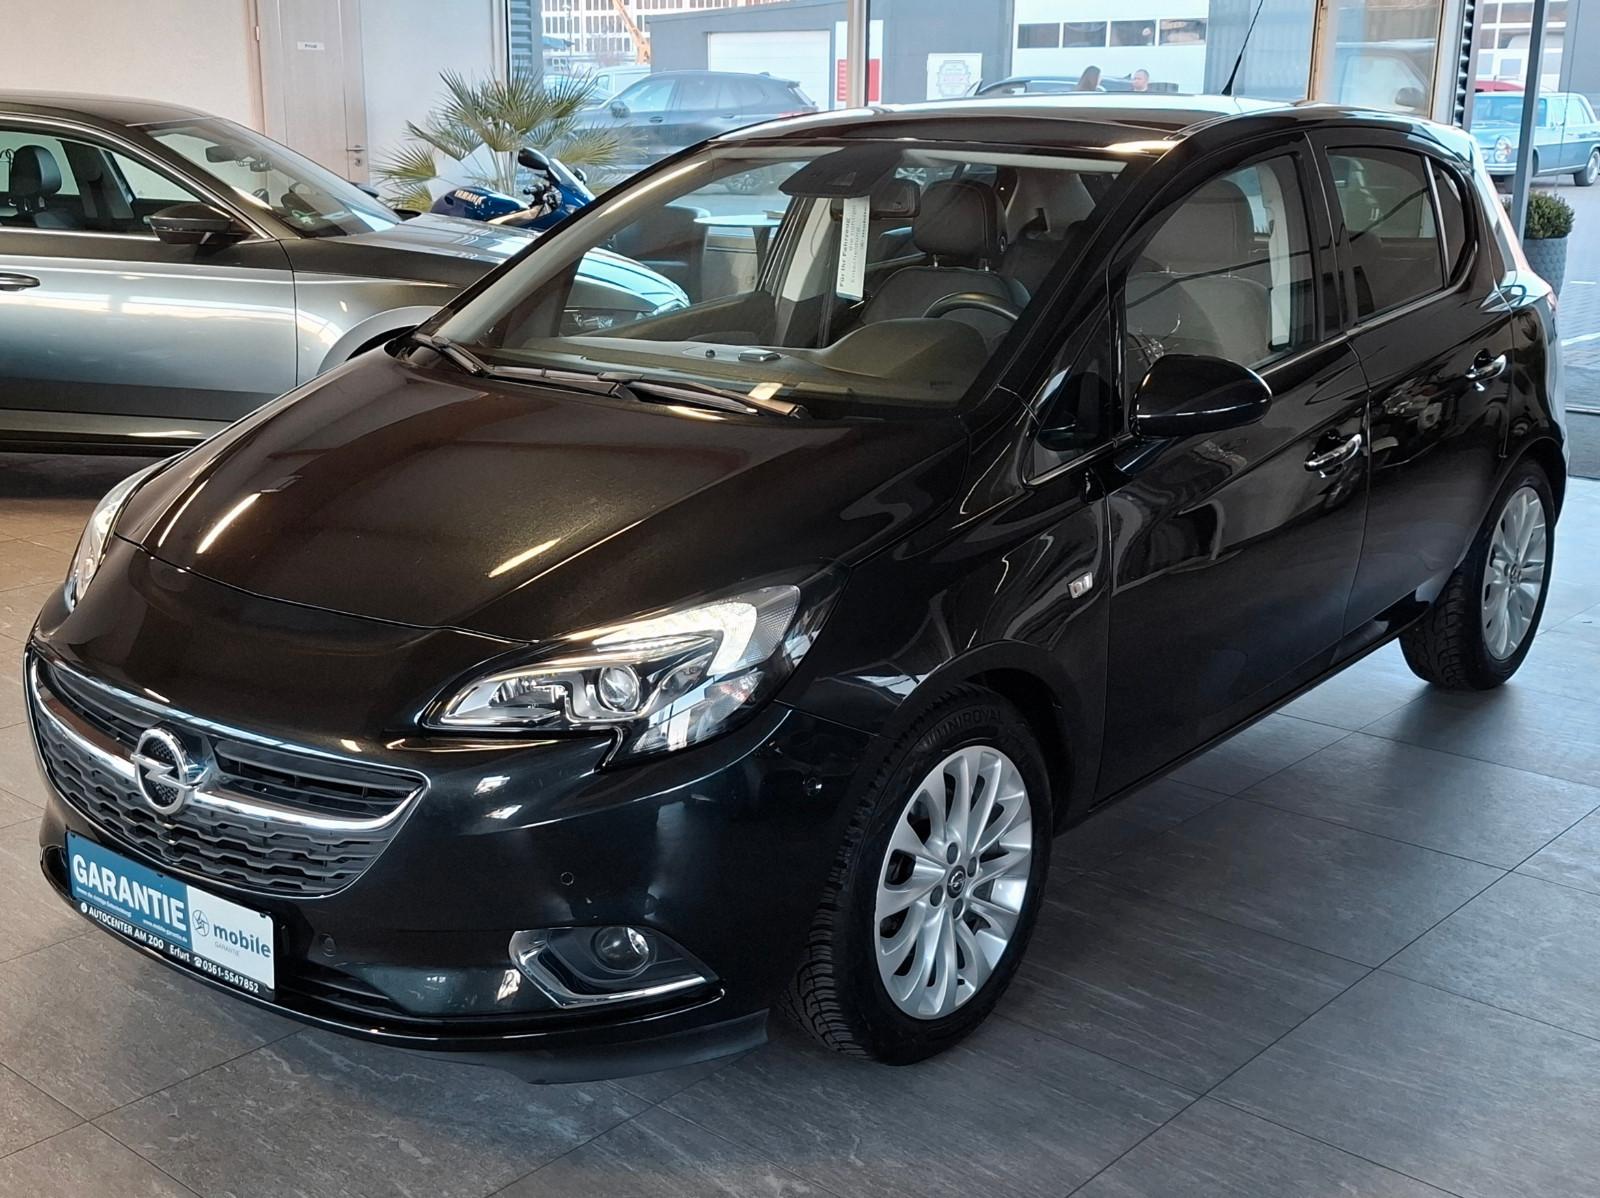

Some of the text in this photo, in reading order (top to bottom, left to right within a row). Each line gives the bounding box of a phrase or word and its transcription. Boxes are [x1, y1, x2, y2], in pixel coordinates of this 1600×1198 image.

[454, 190, 482, 205] YAMAHA
[73, 854, 187, 932] GARANTIE
[88, 906, 259, 993] AUTOCENTER AM ZOO Erfurt 0361-5547852
[213, 923, 271, 958] mobile
